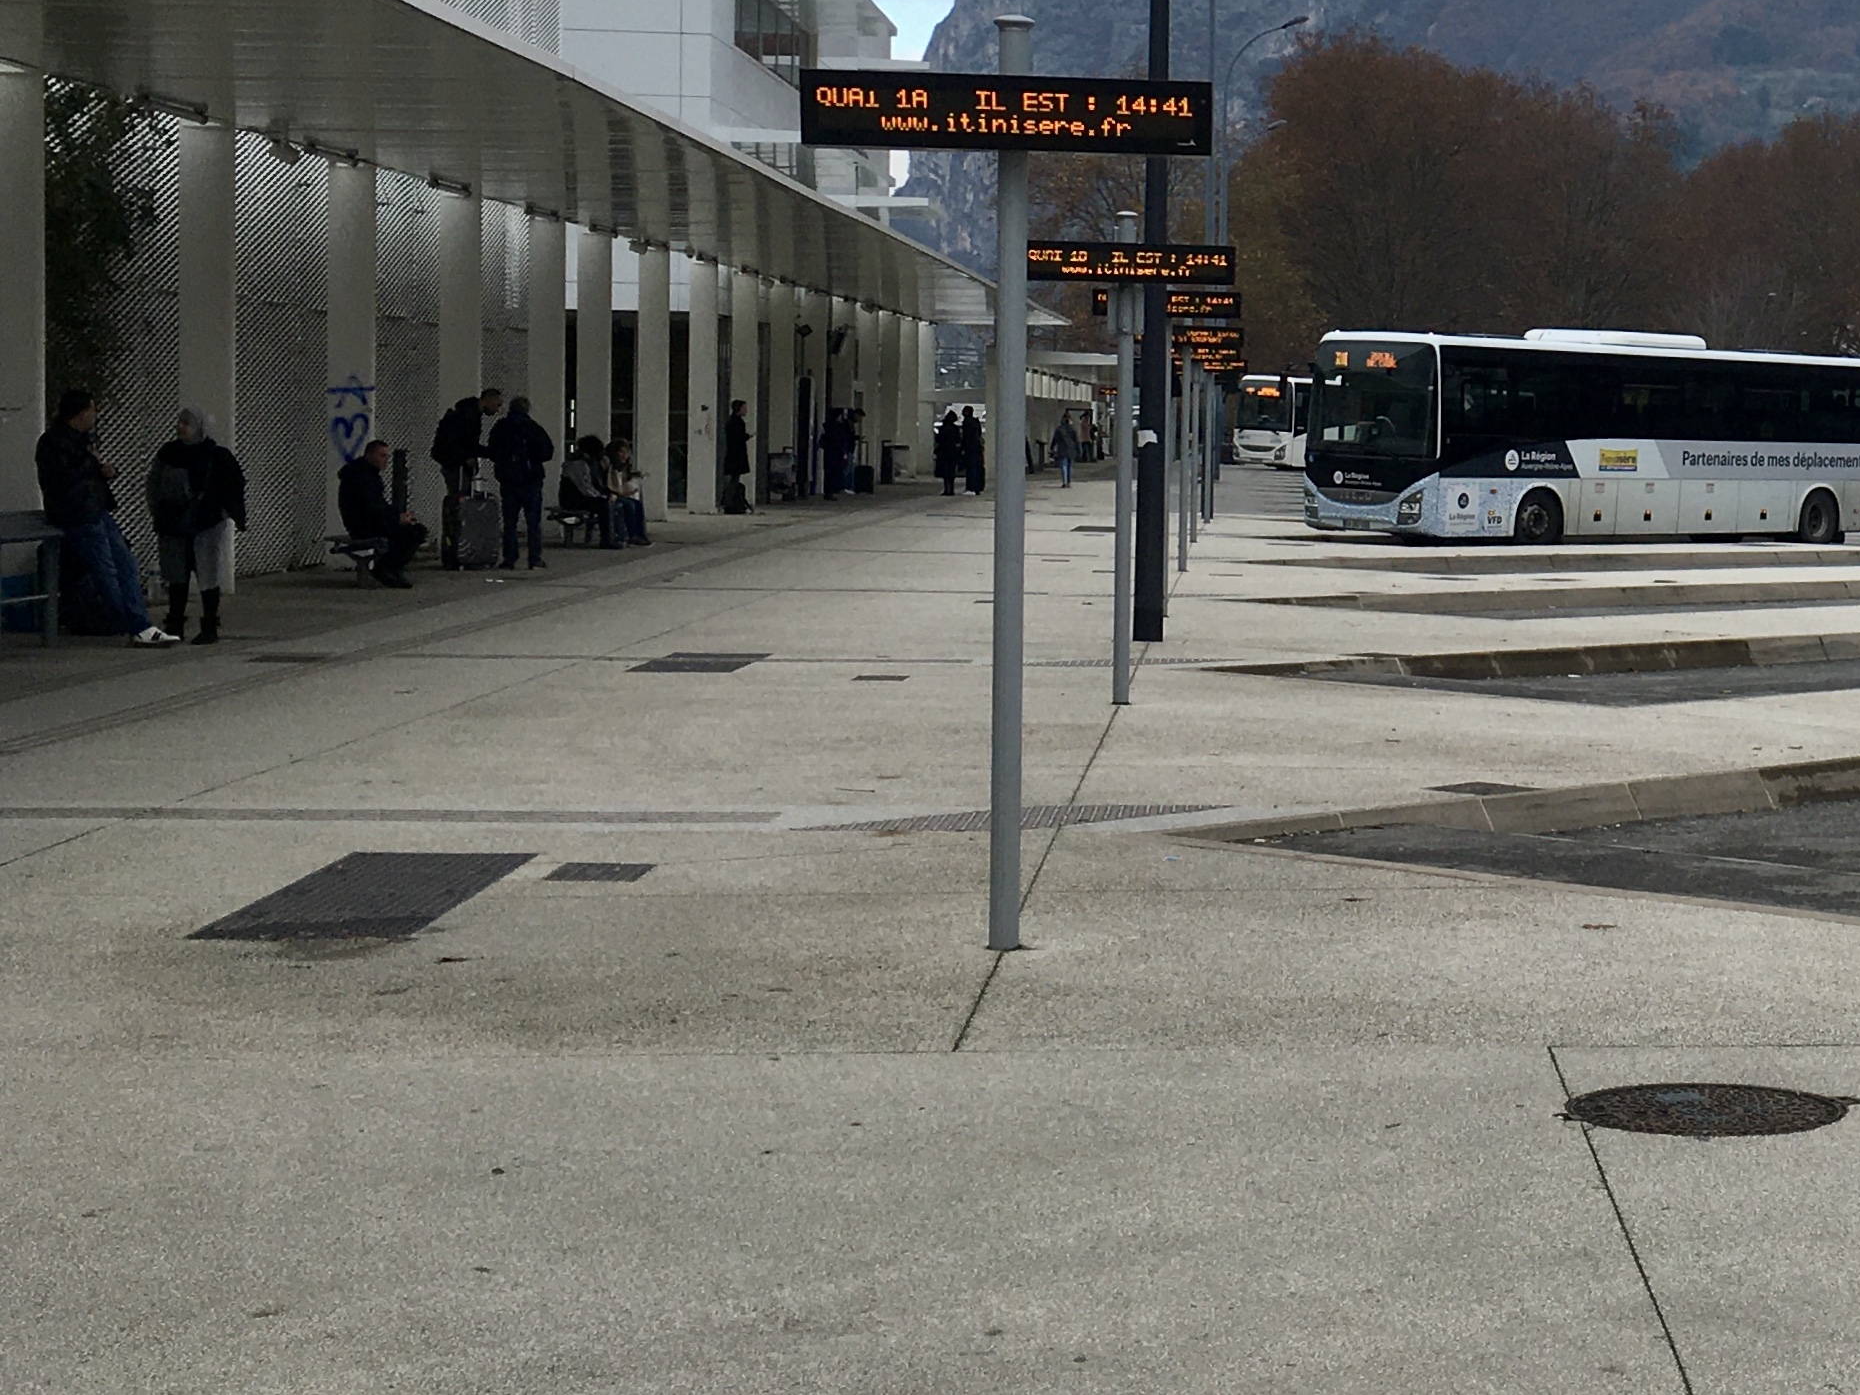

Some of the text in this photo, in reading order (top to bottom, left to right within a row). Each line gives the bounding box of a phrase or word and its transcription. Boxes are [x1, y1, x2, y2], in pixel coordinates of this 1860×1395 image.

[815, 86, 880, 108] QUAI
[896, 88, 928, 109] 1A
[975, 90, 1007, 112] IL
[1022, 92, 1070, 113] EST
[1116, 96, 1194, 118] 14:41
[881, 113, 1133, 137] www.itinisere.fr
[1185, 253, 1228, 266] 14:41
[1521, 450, 1557, 463] La Région
[1682, 449, 1748, 467] Partenaires
[1750, 451, 1765, 467] de
[1767, 454, 1790, 468] mes
[1487, 515, 1503, 525] VFD
